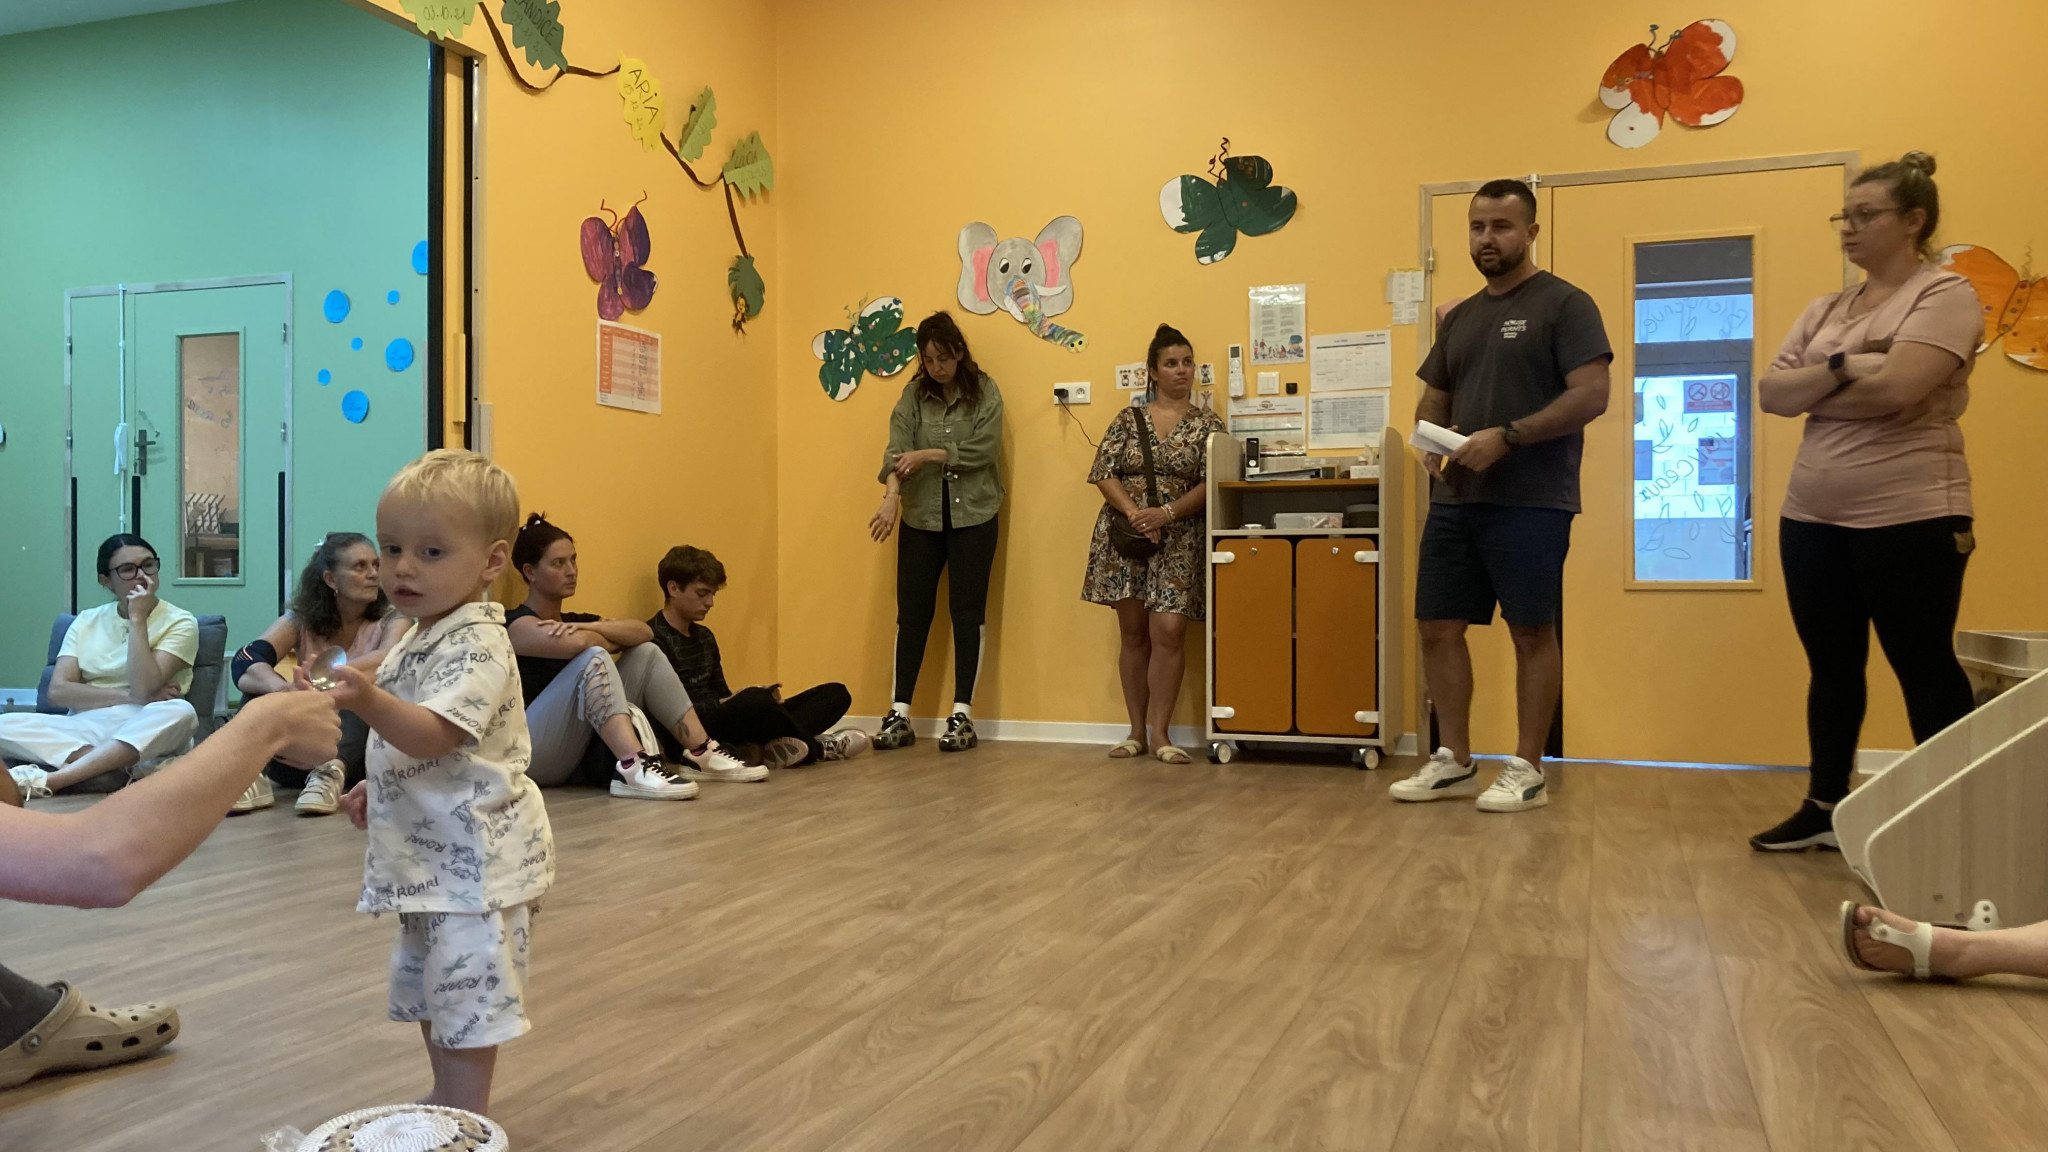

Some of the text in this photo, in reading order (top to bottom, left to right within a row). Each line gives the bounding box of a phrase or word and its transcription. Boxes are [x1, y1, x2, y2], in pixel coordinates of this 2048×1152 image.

[397, 759, 440, 782] ROAR!
[404, 834, 447, 853] ROAR!
[397, 876, 439, 899] ROAR!
[434, 975, 481, 995] ROAR!
[447, 1012, 480, 1048] ROAR!
